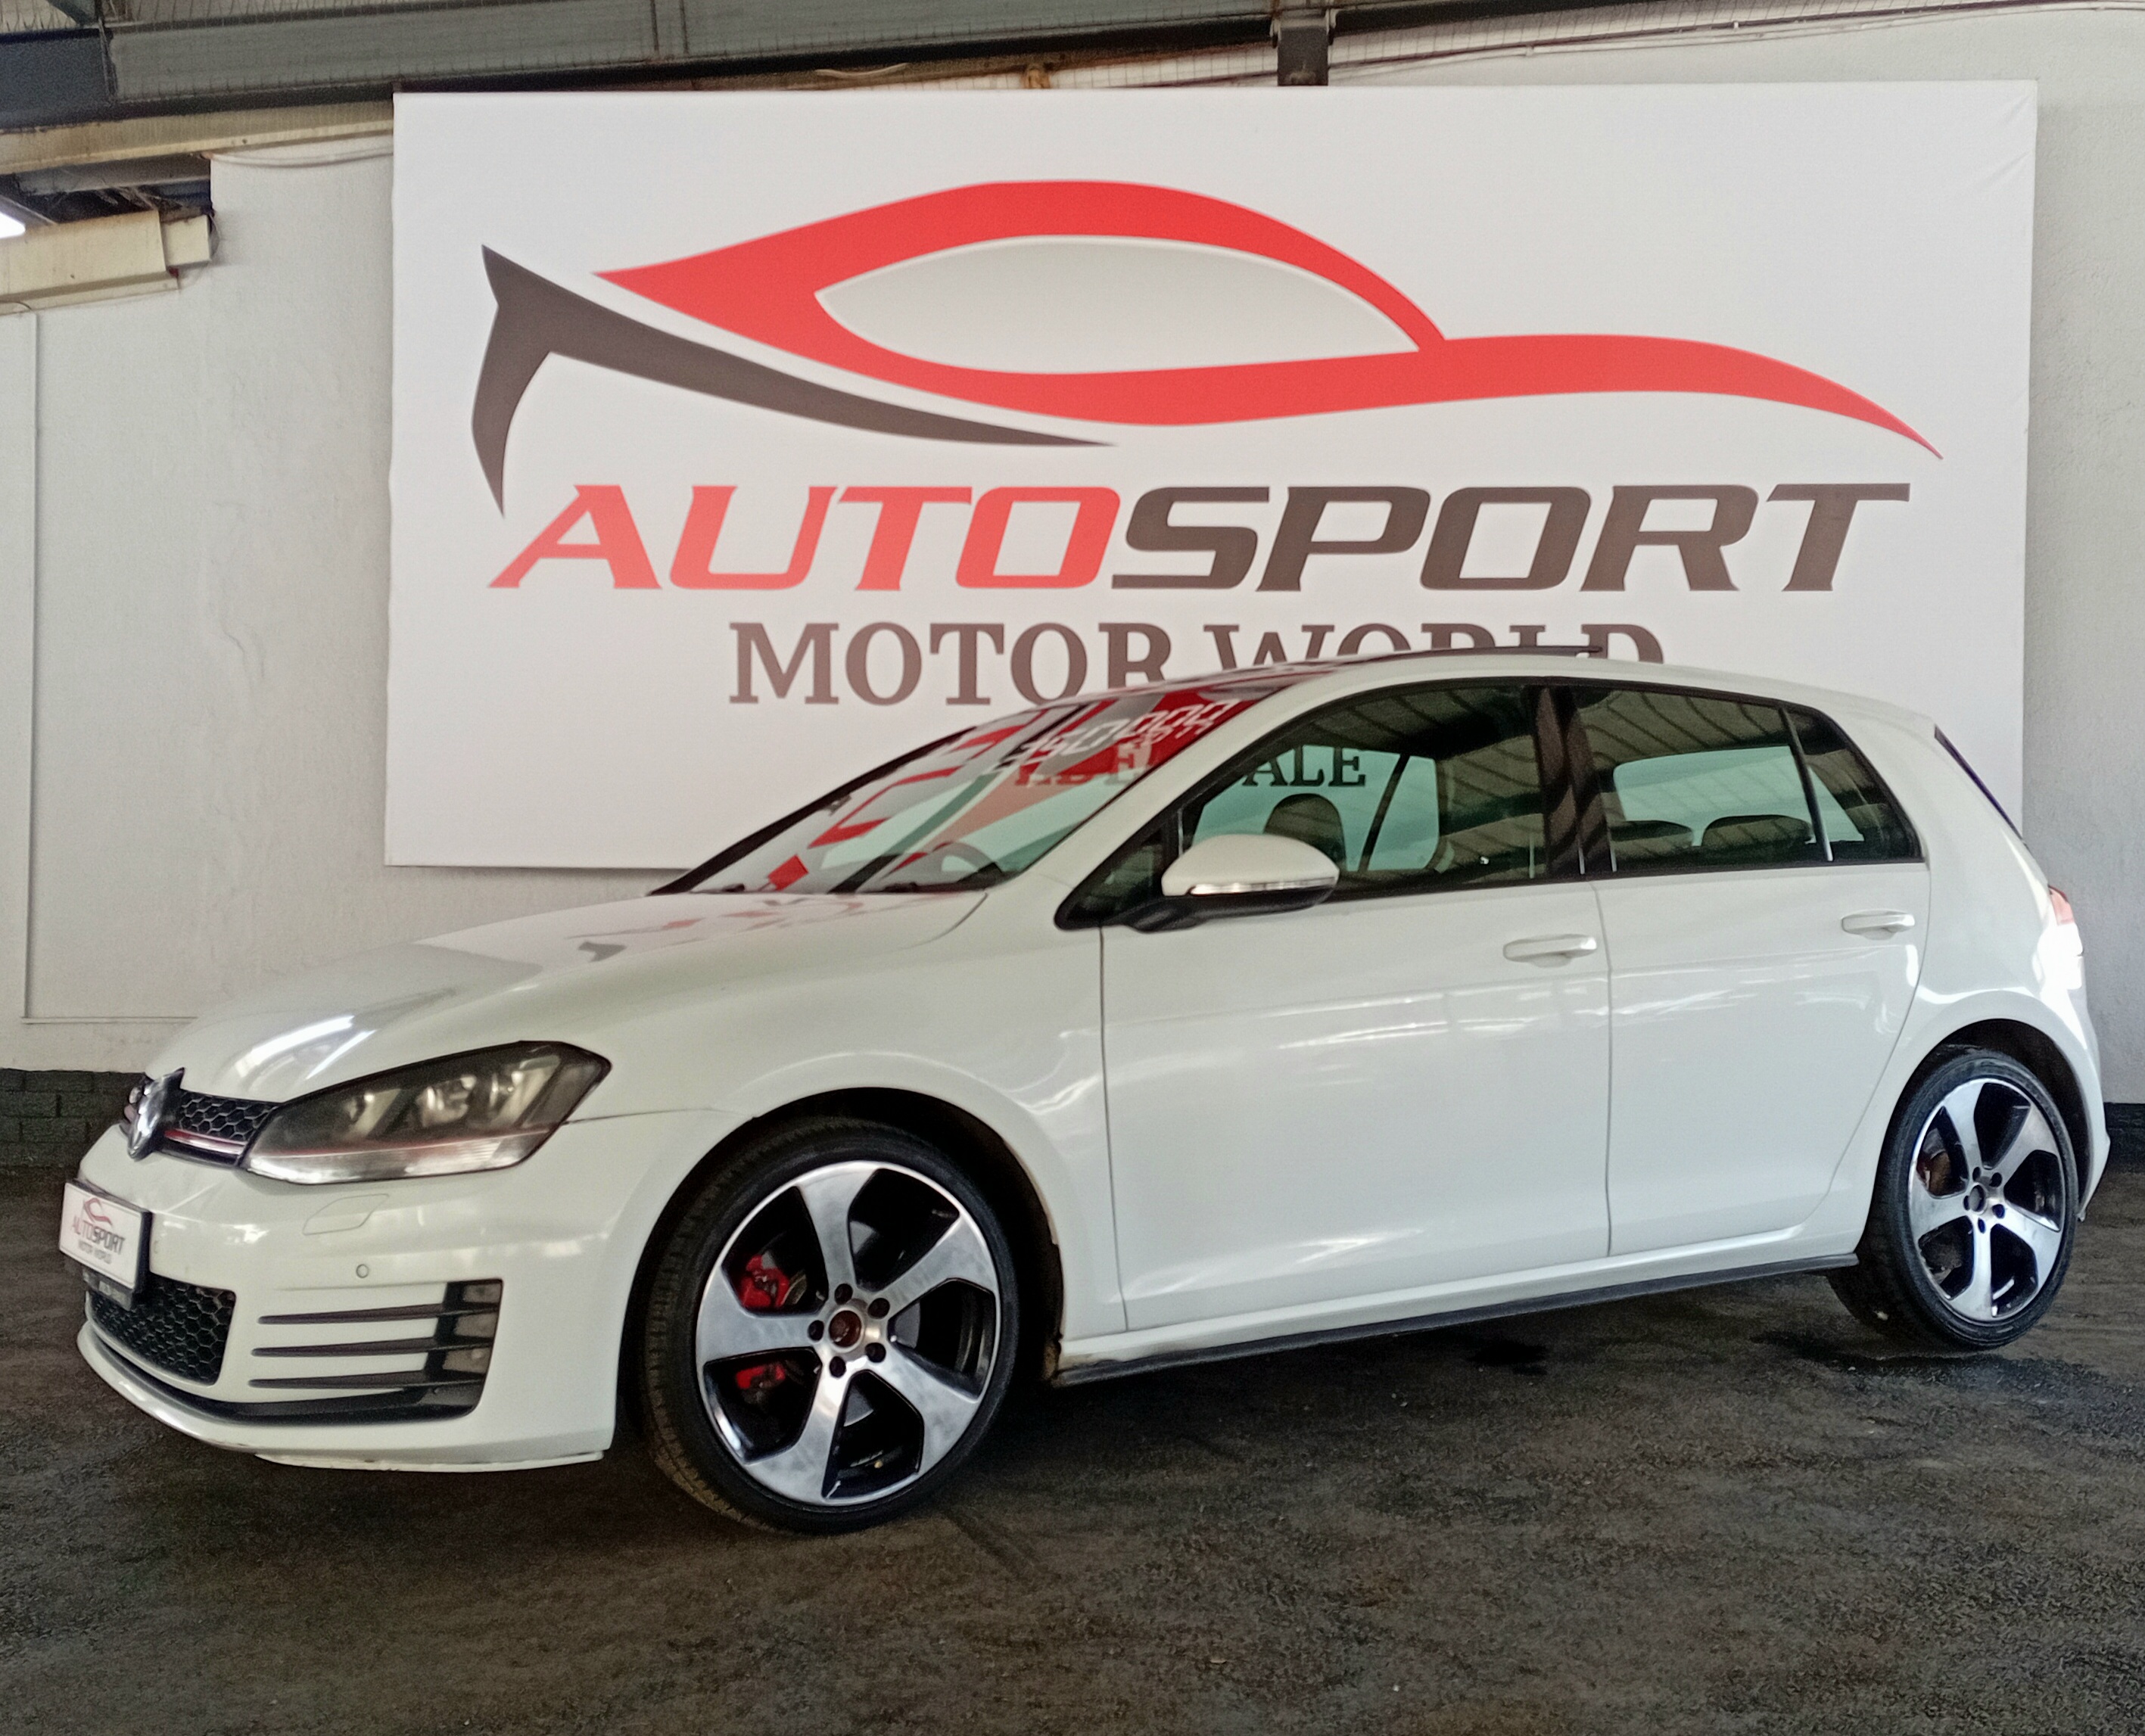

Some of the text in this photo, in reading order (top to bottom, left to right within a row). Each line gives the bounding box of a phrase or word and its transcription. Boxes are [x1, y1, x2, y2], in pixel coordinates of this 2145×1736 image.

[490, 484, 1910, 592] AUTOSPORT
[730, 622, 1173, 705] MOTOR
[1242, 745, 1366, 786] ALE
